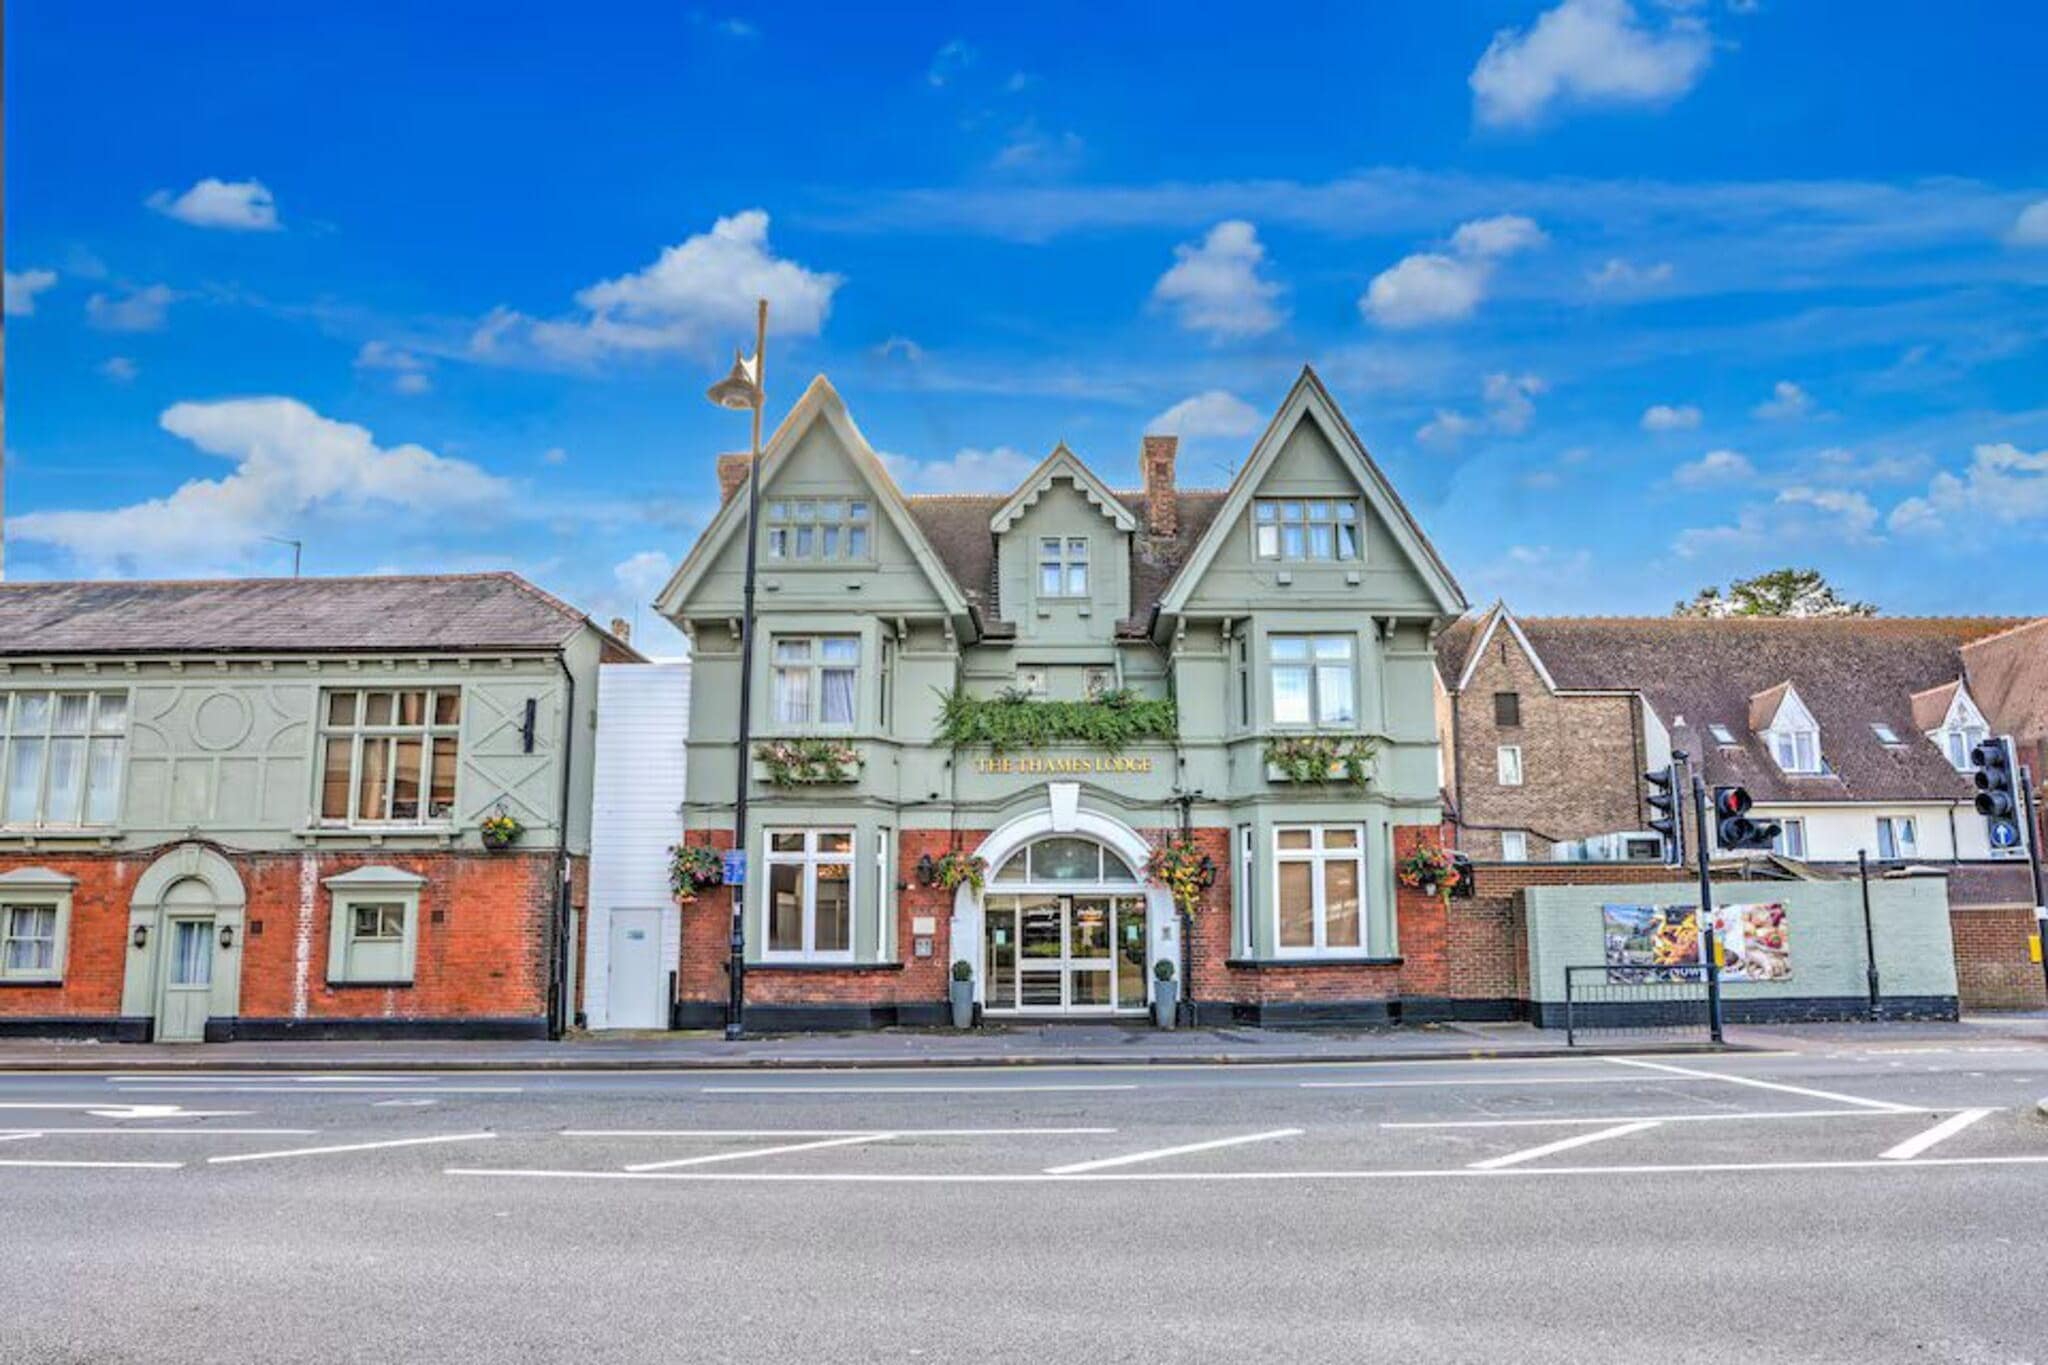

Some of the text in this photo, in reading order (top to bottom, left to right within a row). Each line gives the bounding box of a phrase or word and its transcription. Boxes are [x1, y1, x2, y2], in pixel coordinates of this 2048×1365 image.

[978, 756, 1152, 773] THE THAMES LODGE
